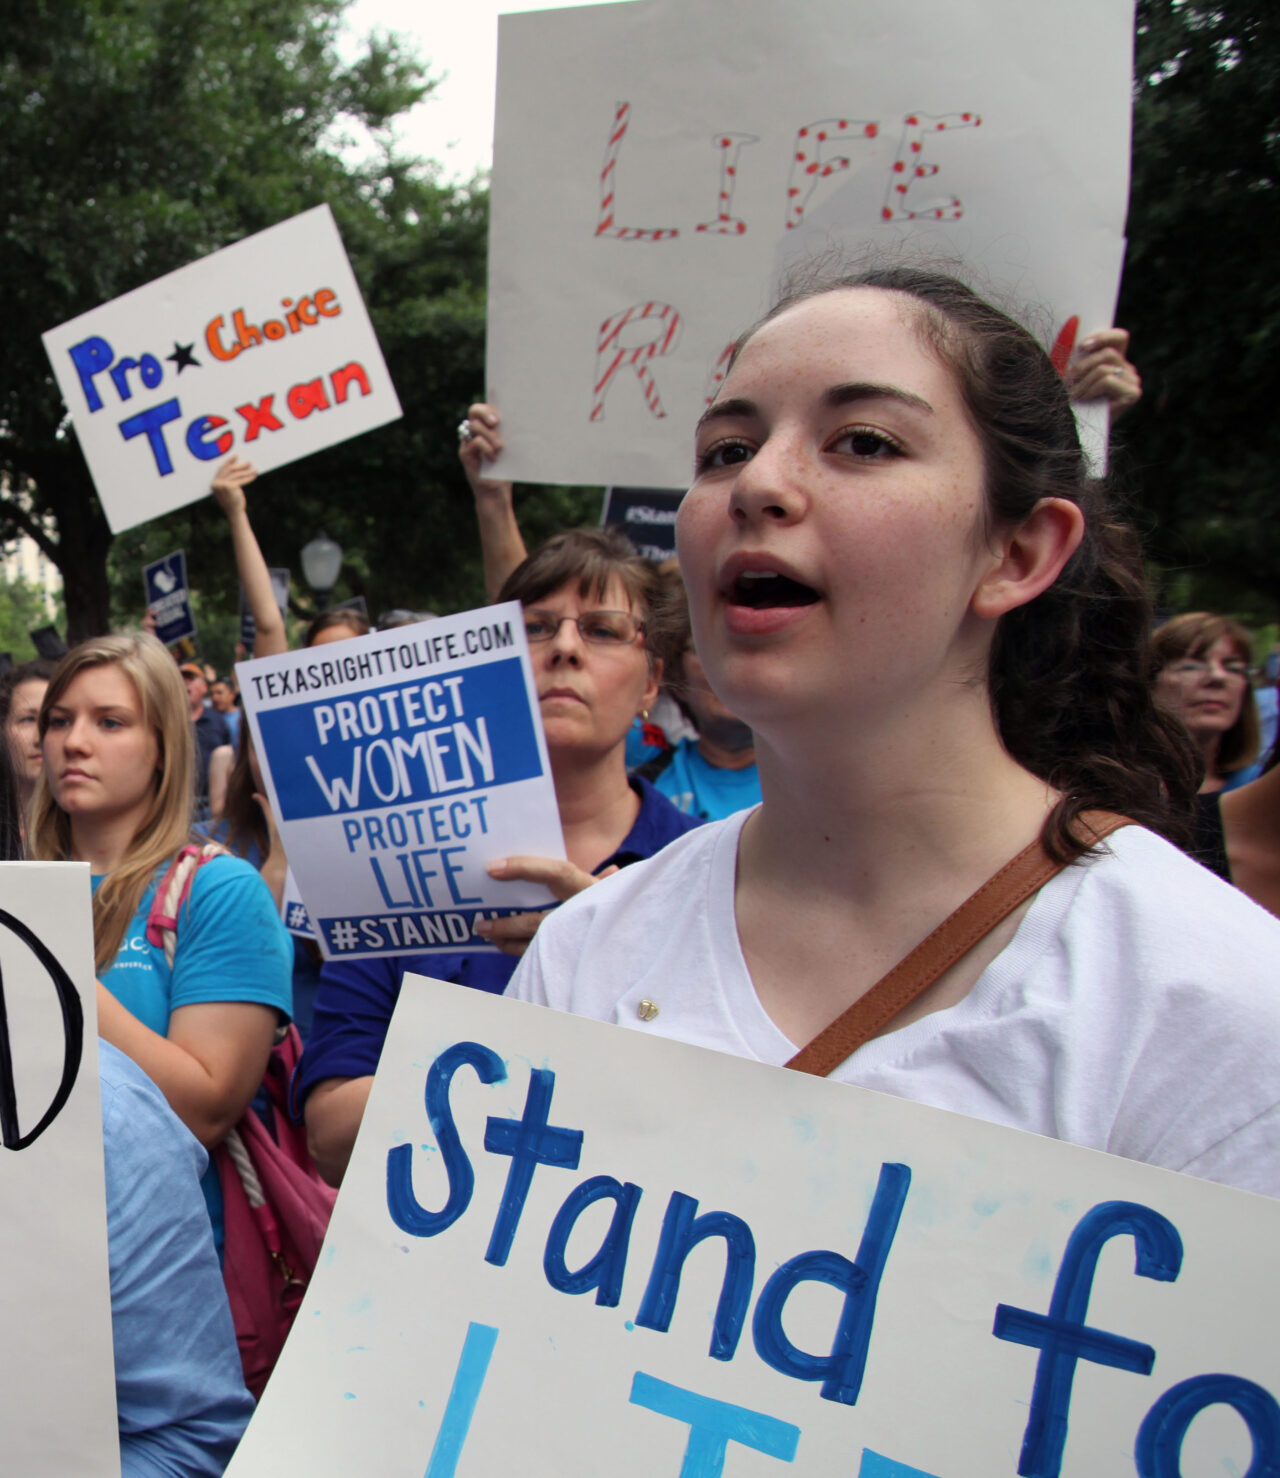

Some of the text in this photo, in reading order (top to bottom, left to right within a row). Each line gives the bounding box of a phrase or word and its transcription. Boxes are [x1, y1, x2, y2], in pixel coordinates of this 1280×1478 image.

[594, 100, 983, 241] LIFE
[67, 287, 342, 413] Pro Choice
[118, 361, 372, 477] Texan
[252, 621, 515, 701] TEXASRIGHTTOLIFE.COM
[313, 676, 465, 745] PROTECT
[305, 717, 495, 812] WOMEN
[342, 796, 490, 853] PROTECT
[369, 846, 483, 910] LIFE
[330, 910, 519, 951] #STAND
[385, 1040, 912, 1407] Stand
